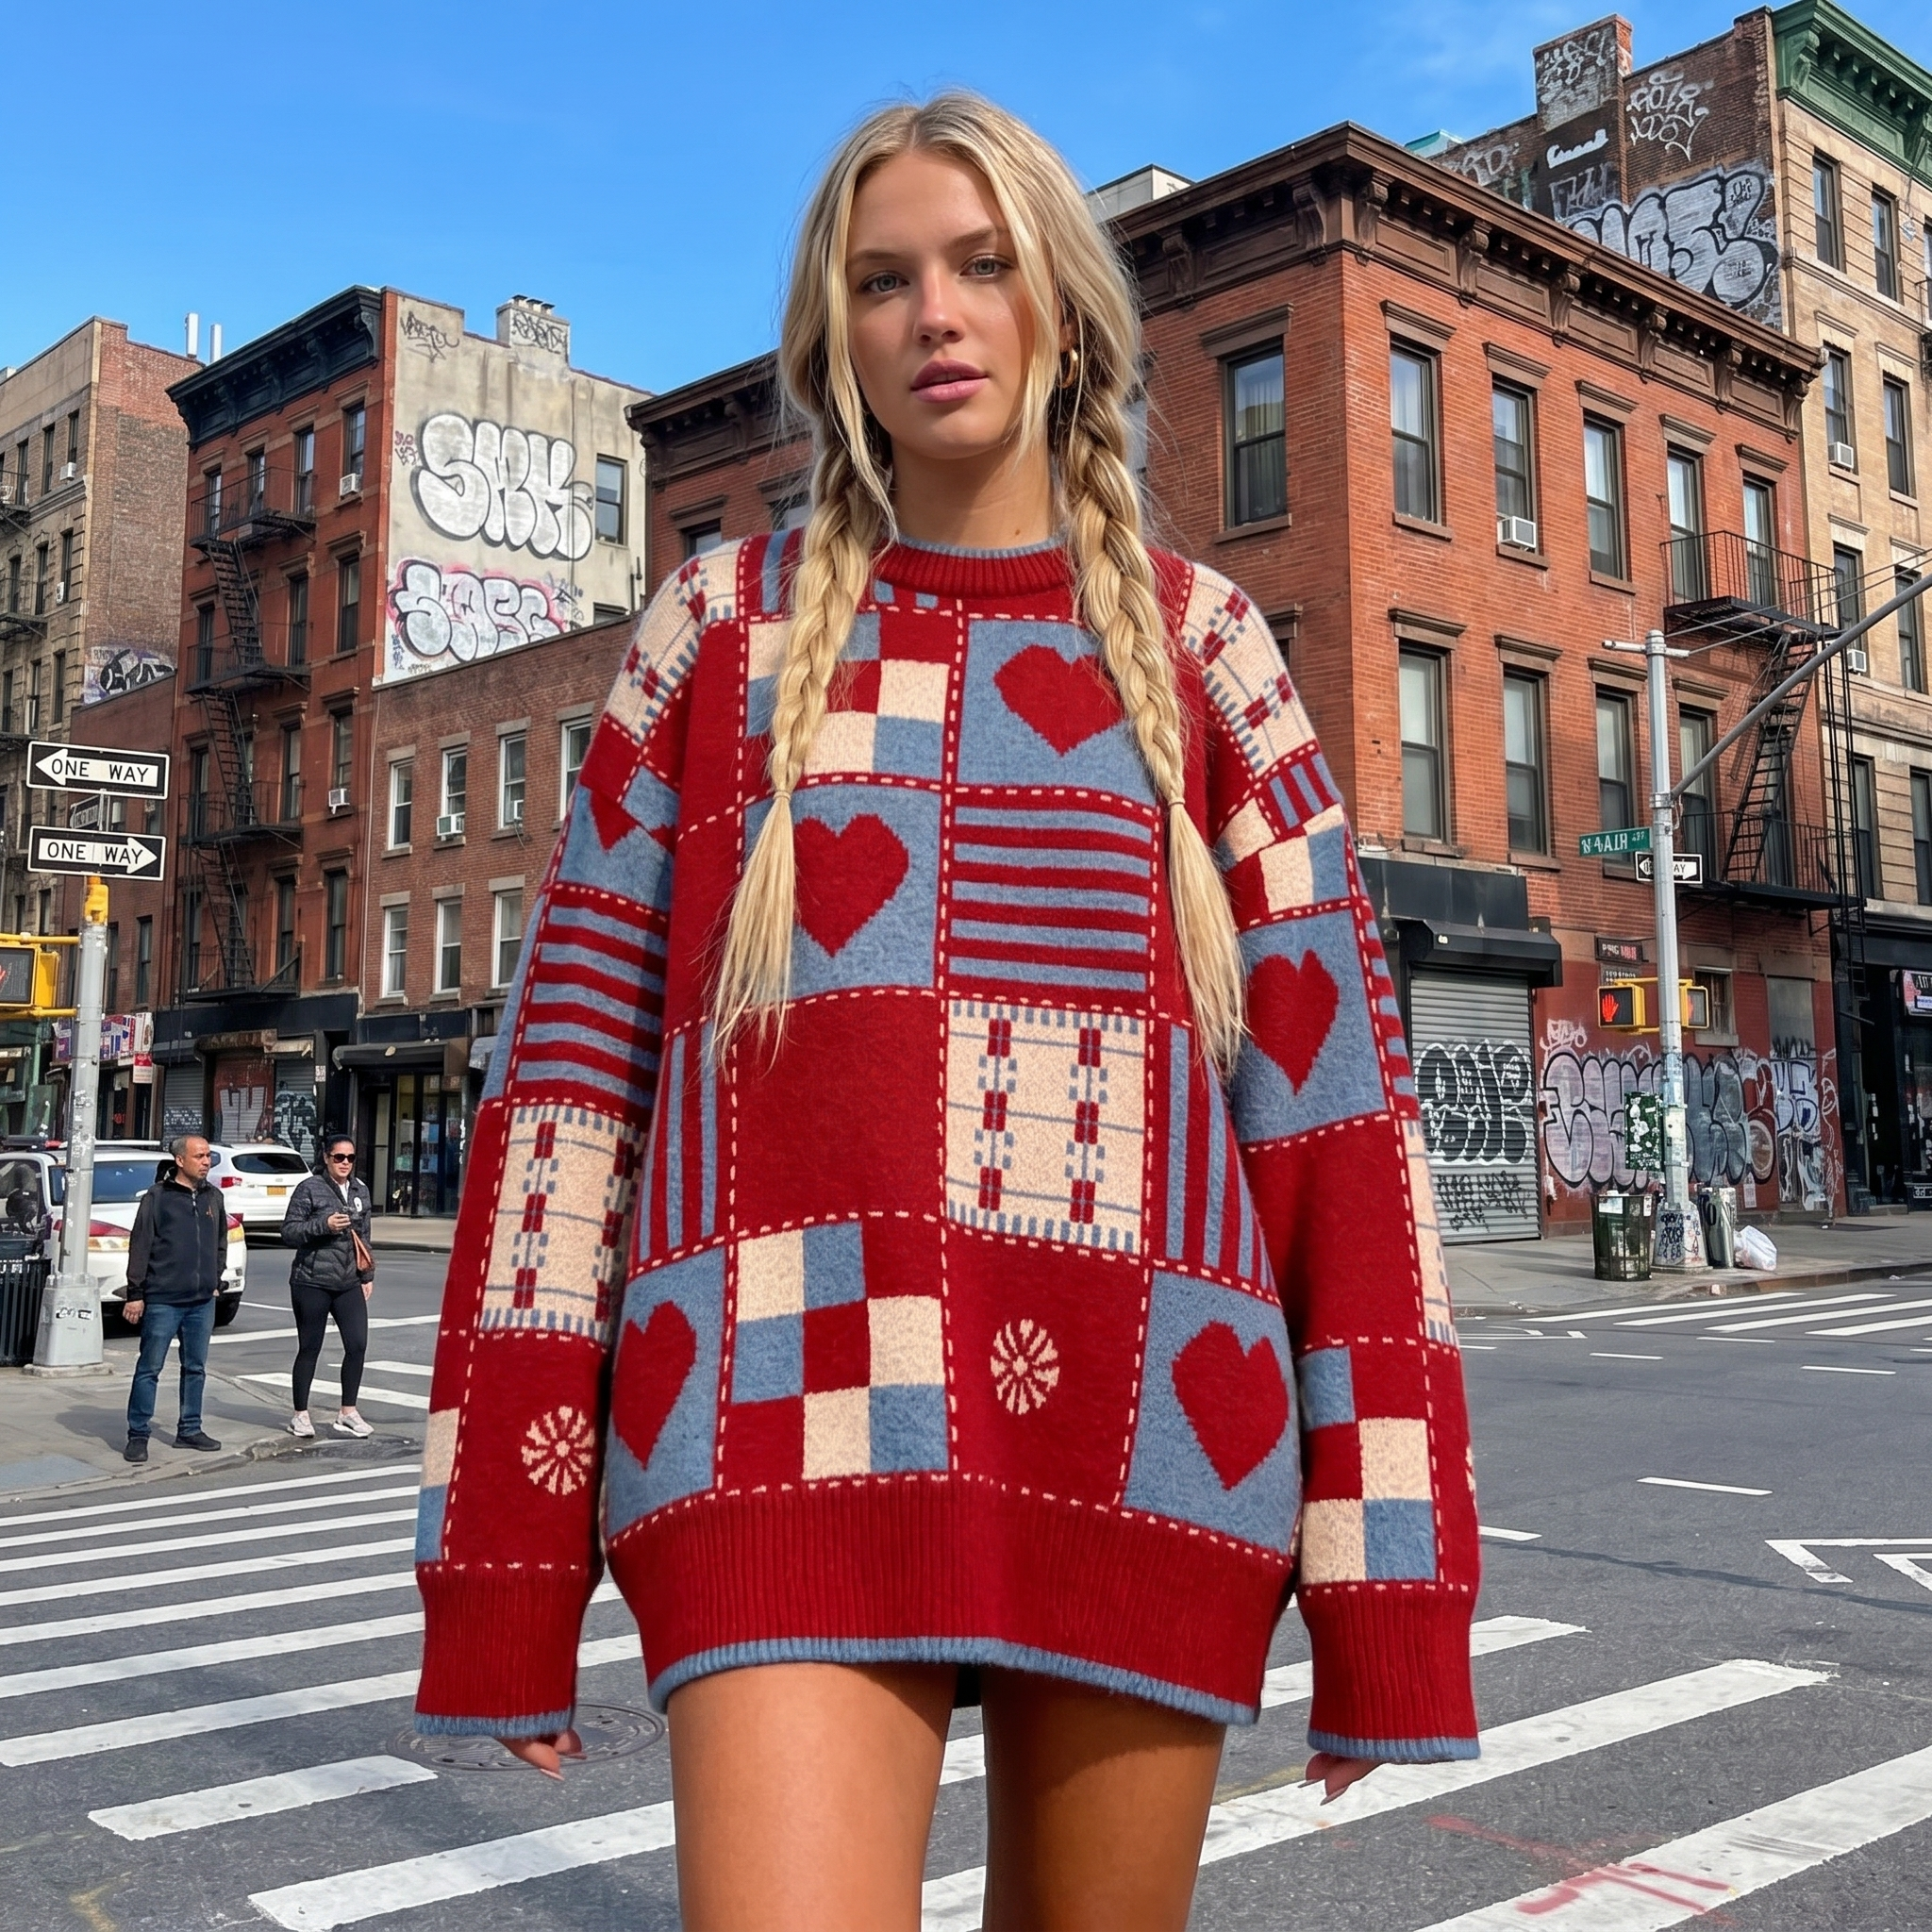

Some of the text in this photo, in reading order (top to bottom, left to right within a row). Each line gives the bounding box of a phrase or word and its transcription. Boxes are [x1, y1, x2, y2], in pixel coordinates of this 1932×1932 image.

[51, 758, 149, 783] ONE WAY
[47, 841, 143, 864] ONE WAY
[1674, 863, 1686, 874] AY
